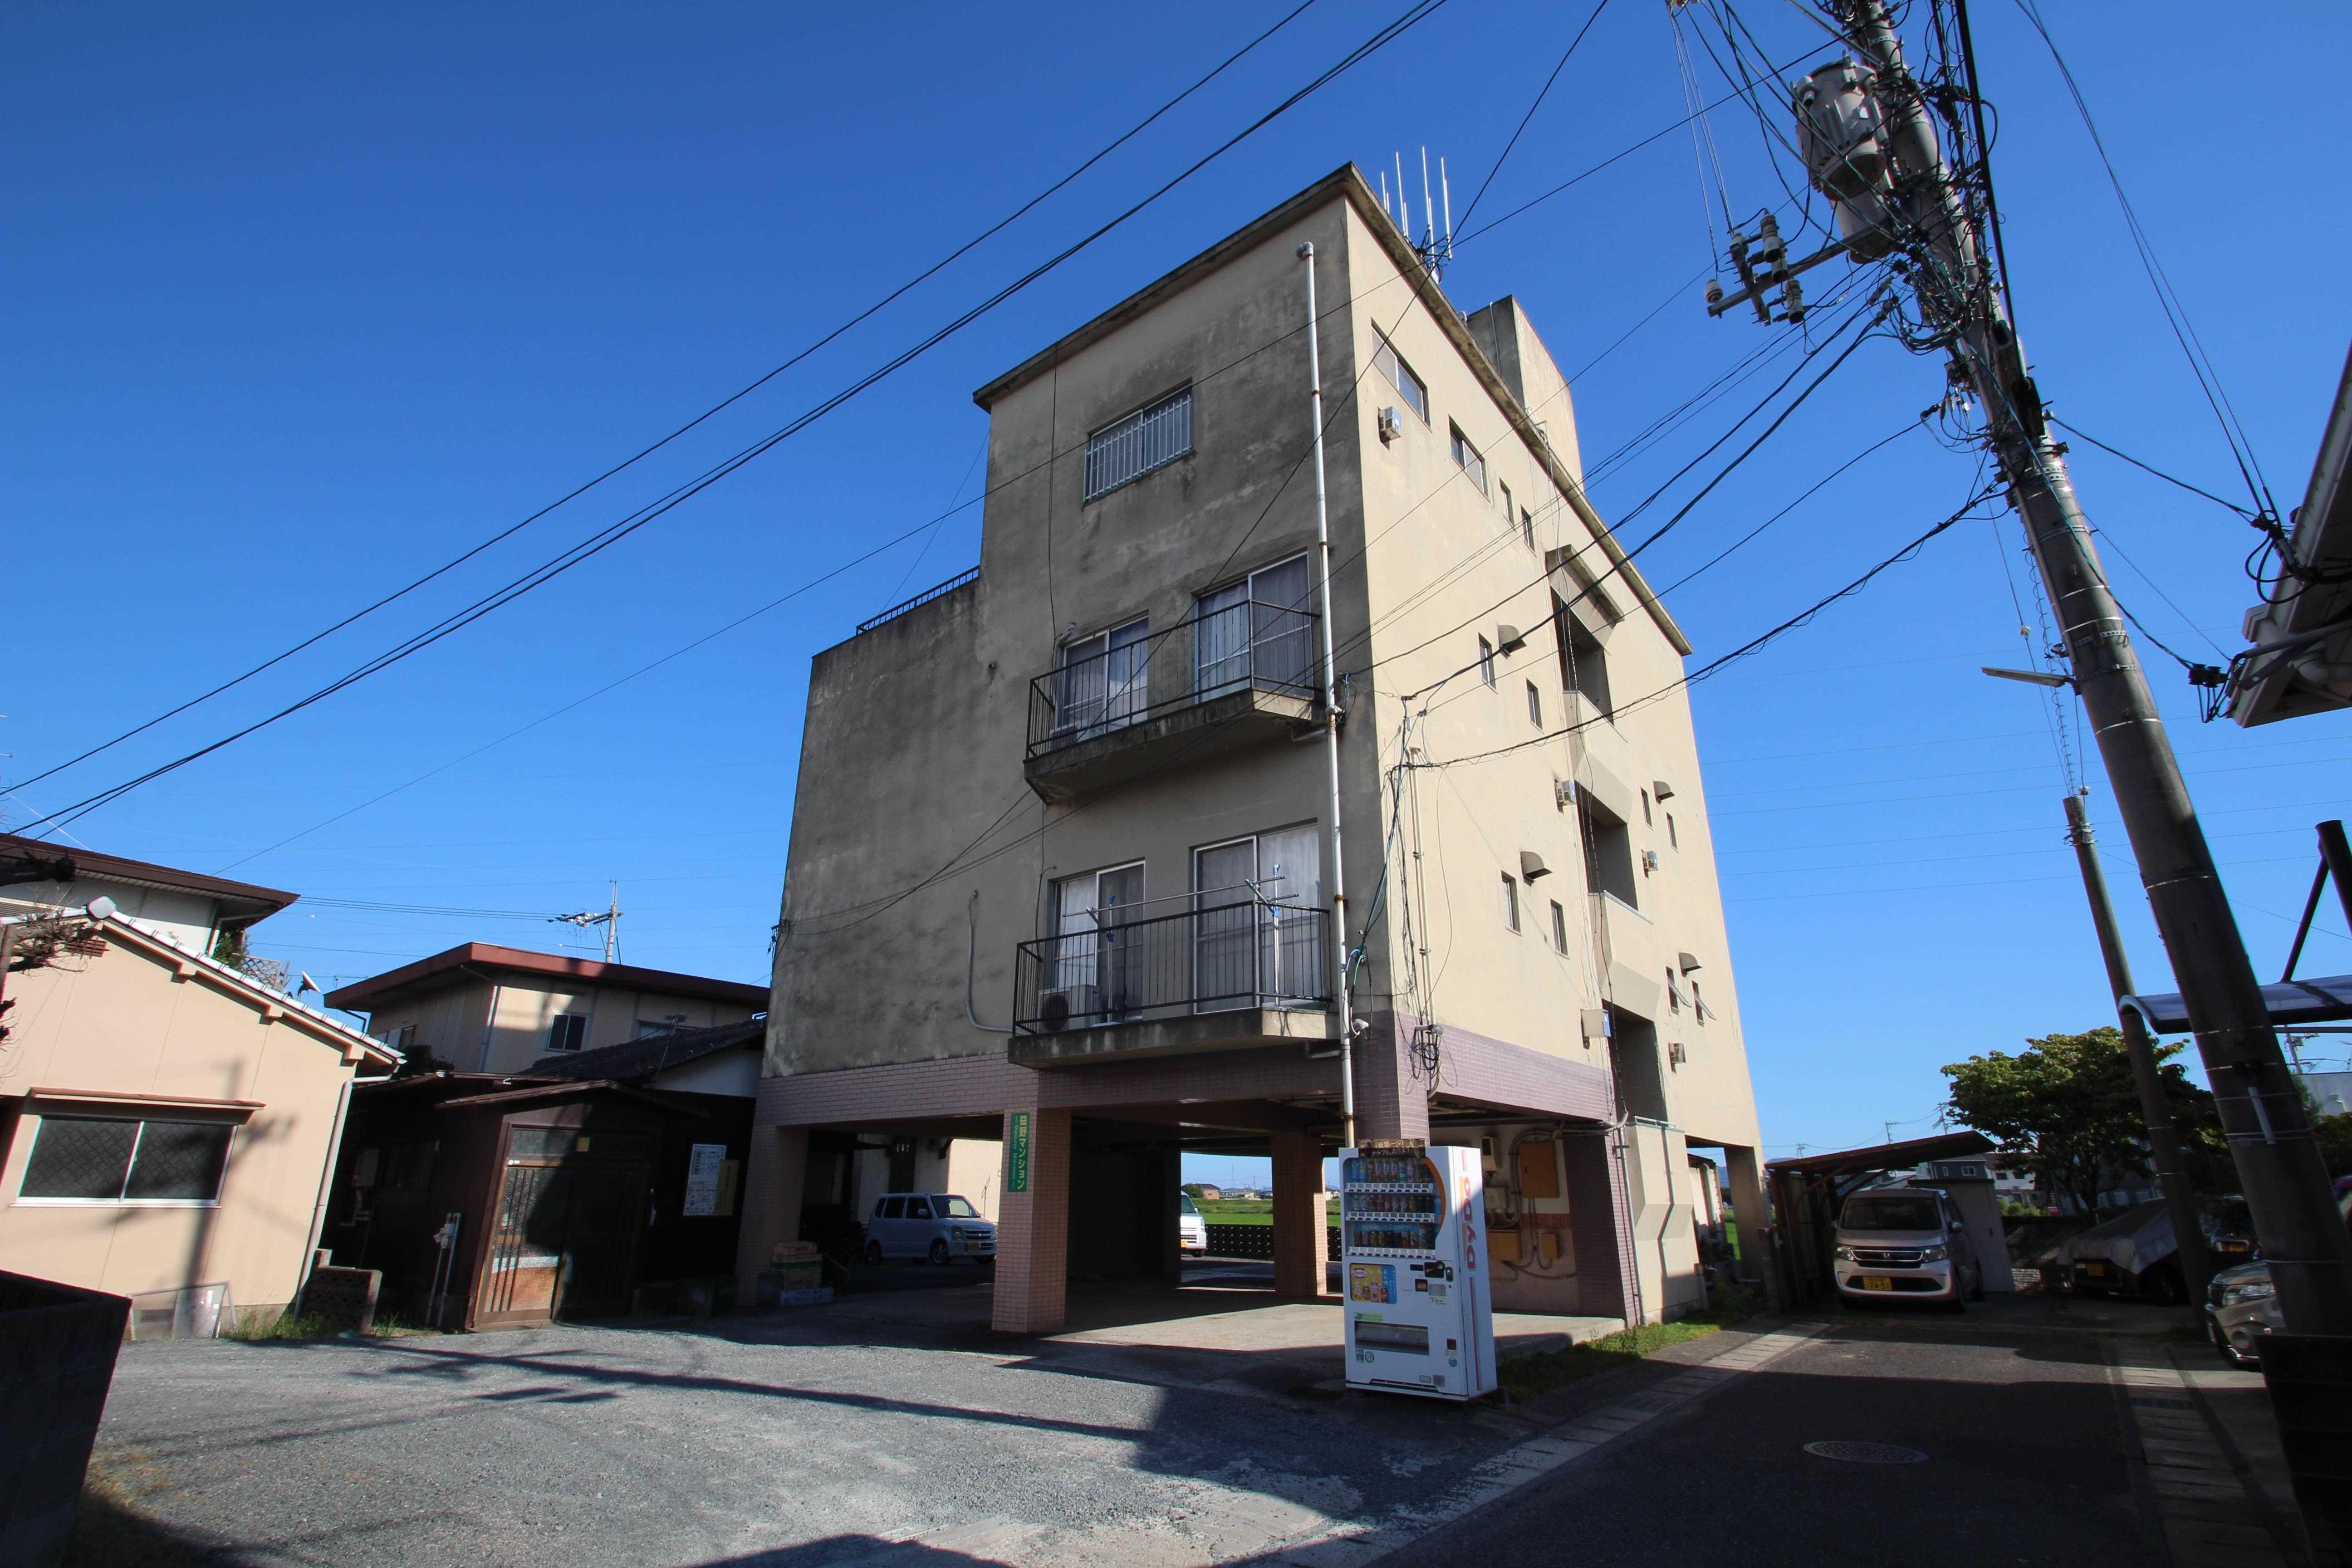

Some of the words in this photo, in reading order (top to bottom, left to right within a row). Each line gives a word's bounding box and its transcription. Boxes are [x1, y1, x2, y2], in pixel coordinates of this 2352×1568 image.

[1017, 1115, 1027, 1189] 益野マンション
